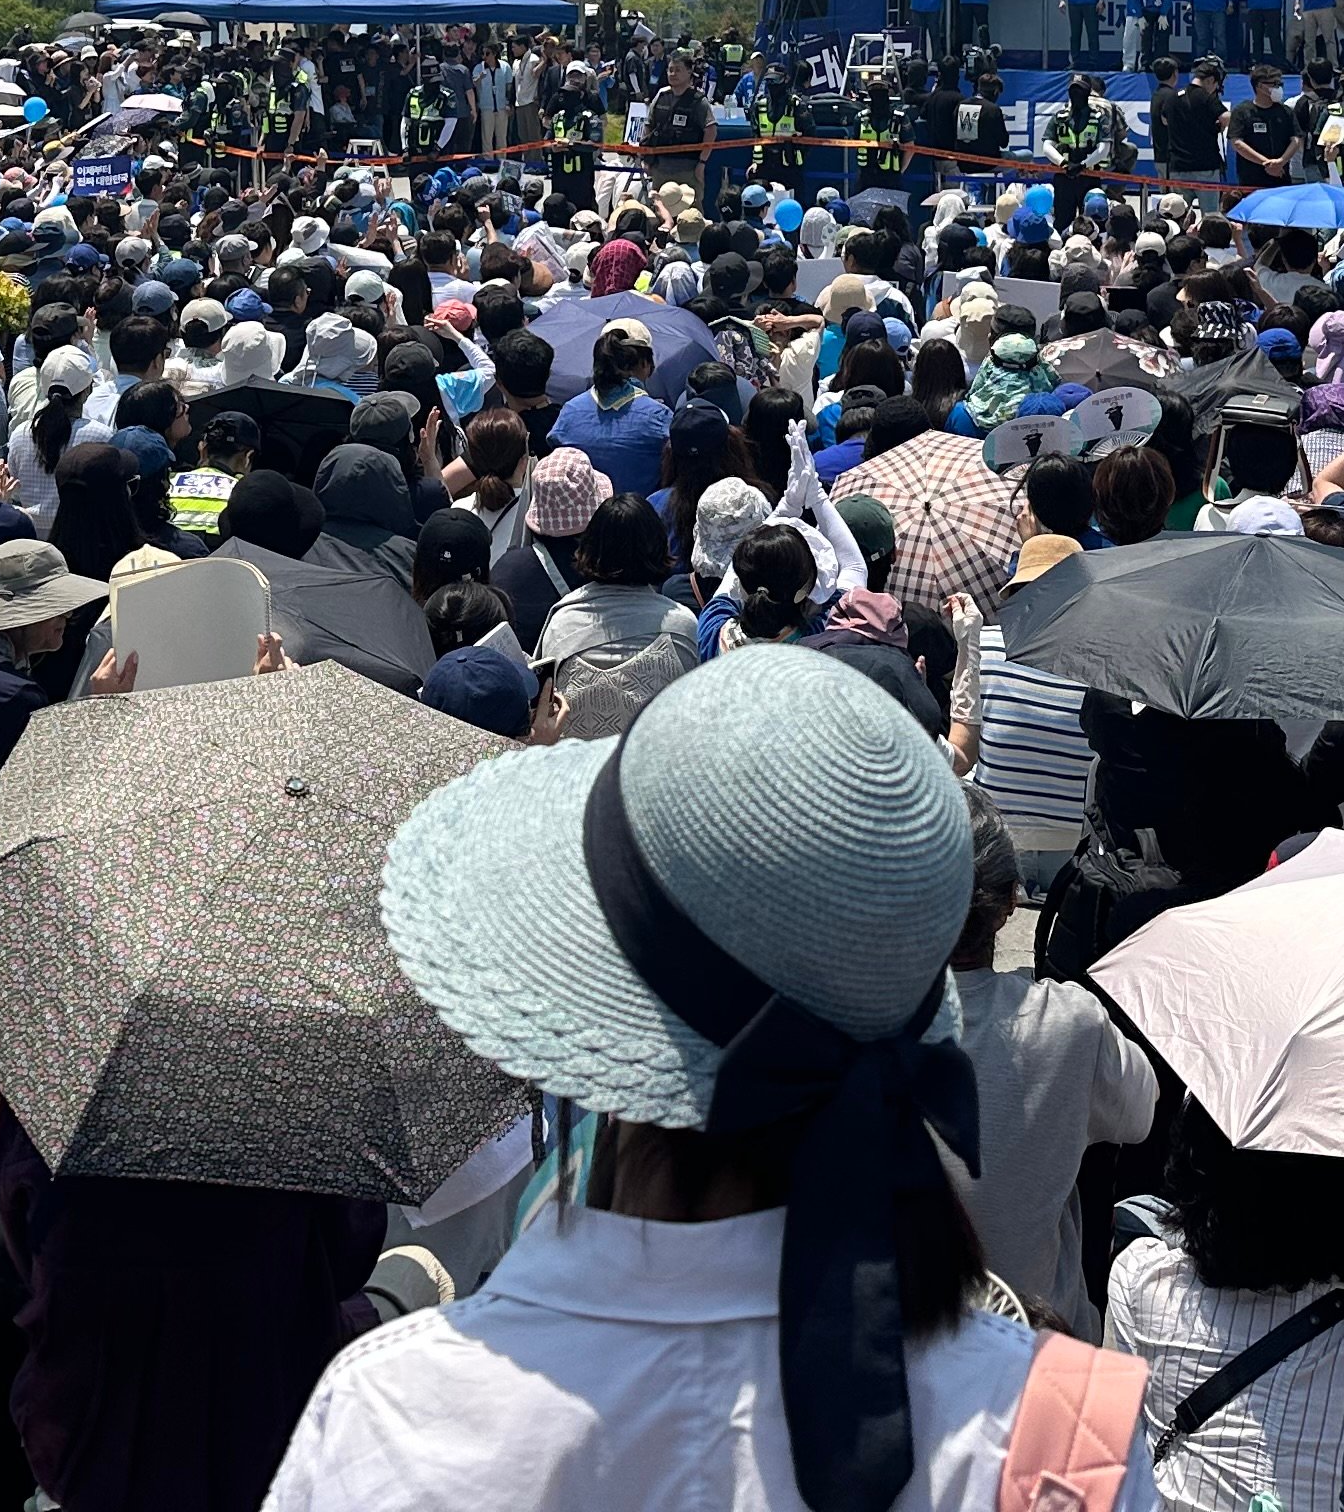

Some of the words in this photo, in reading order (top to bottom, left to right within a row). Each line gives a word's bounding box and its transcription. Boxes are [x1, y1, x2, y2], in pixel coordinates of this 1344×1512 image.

[76, 164, 112, 176] 이제부터
[76, 176, 95, 187] 진짜
[96, 173, 129, 186] 대한민국
